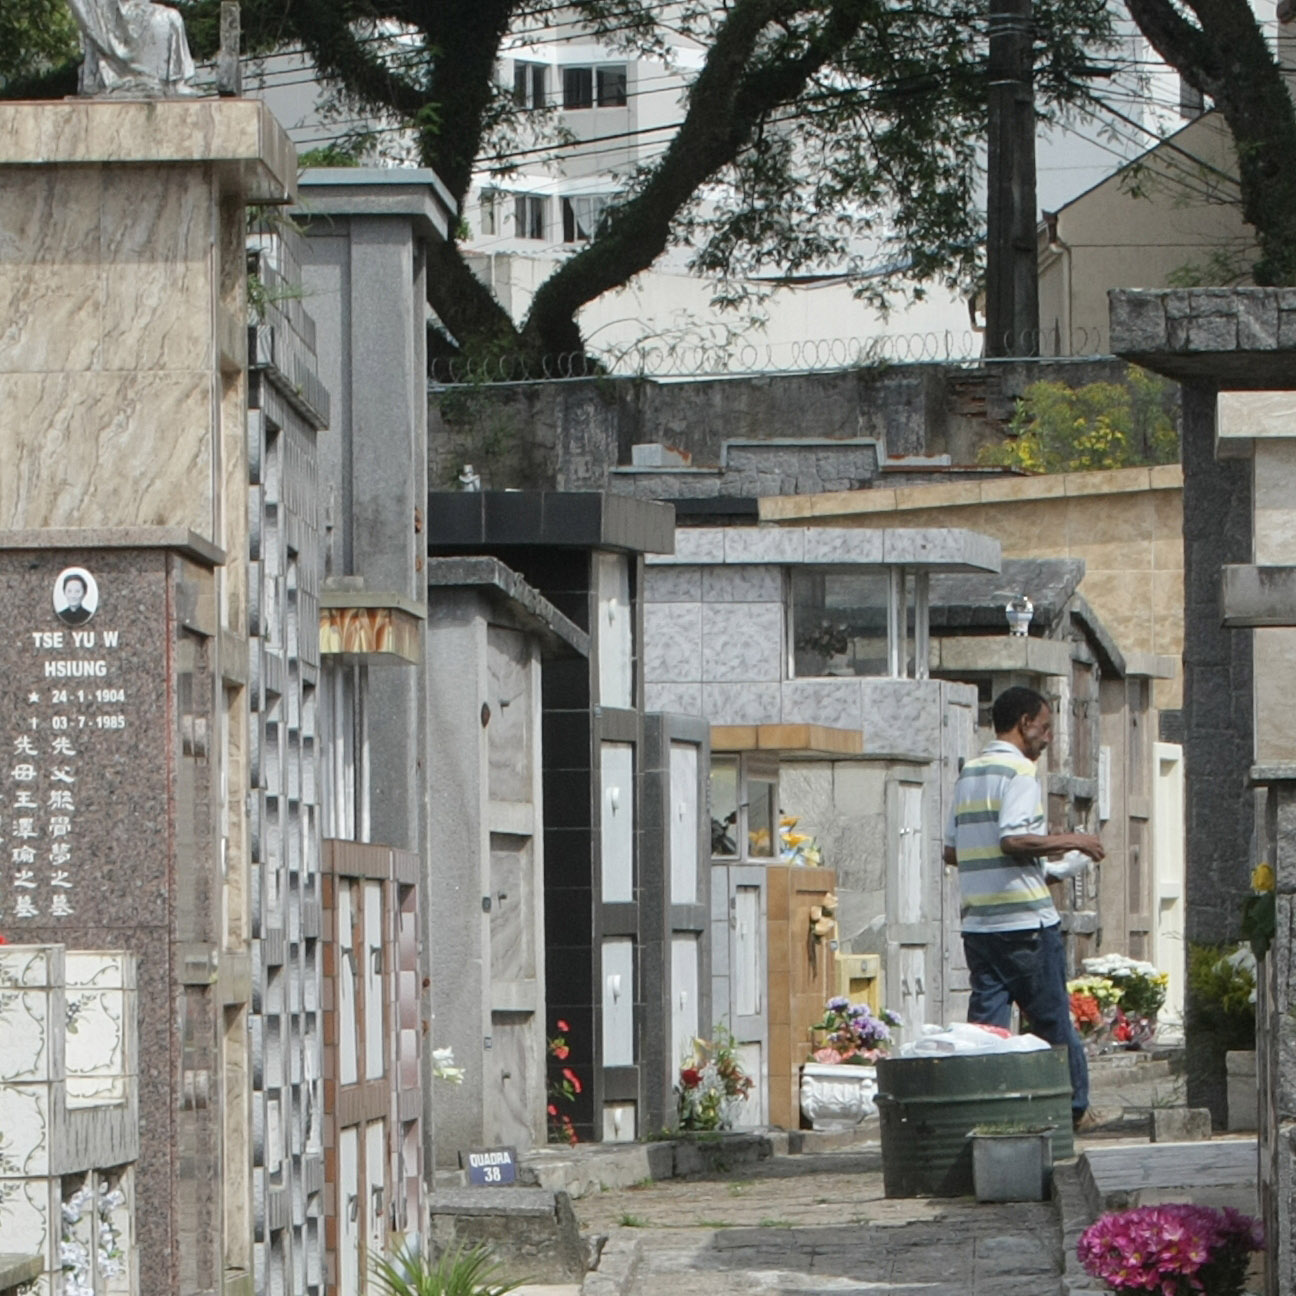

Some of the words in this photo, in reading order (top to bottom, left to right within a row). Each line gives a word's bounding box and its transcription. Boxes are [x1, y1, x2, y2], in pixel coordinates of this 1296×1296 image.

[32, 631, 64, 649] TSE
[72, 631, 95, 648] YU
[103, 631, 119, 648] W
[44, 660, 107, 678] HSIUNG
[470, 1152, 510, 1168] QUADRA
[483, 1166, 501, 1182] 38
